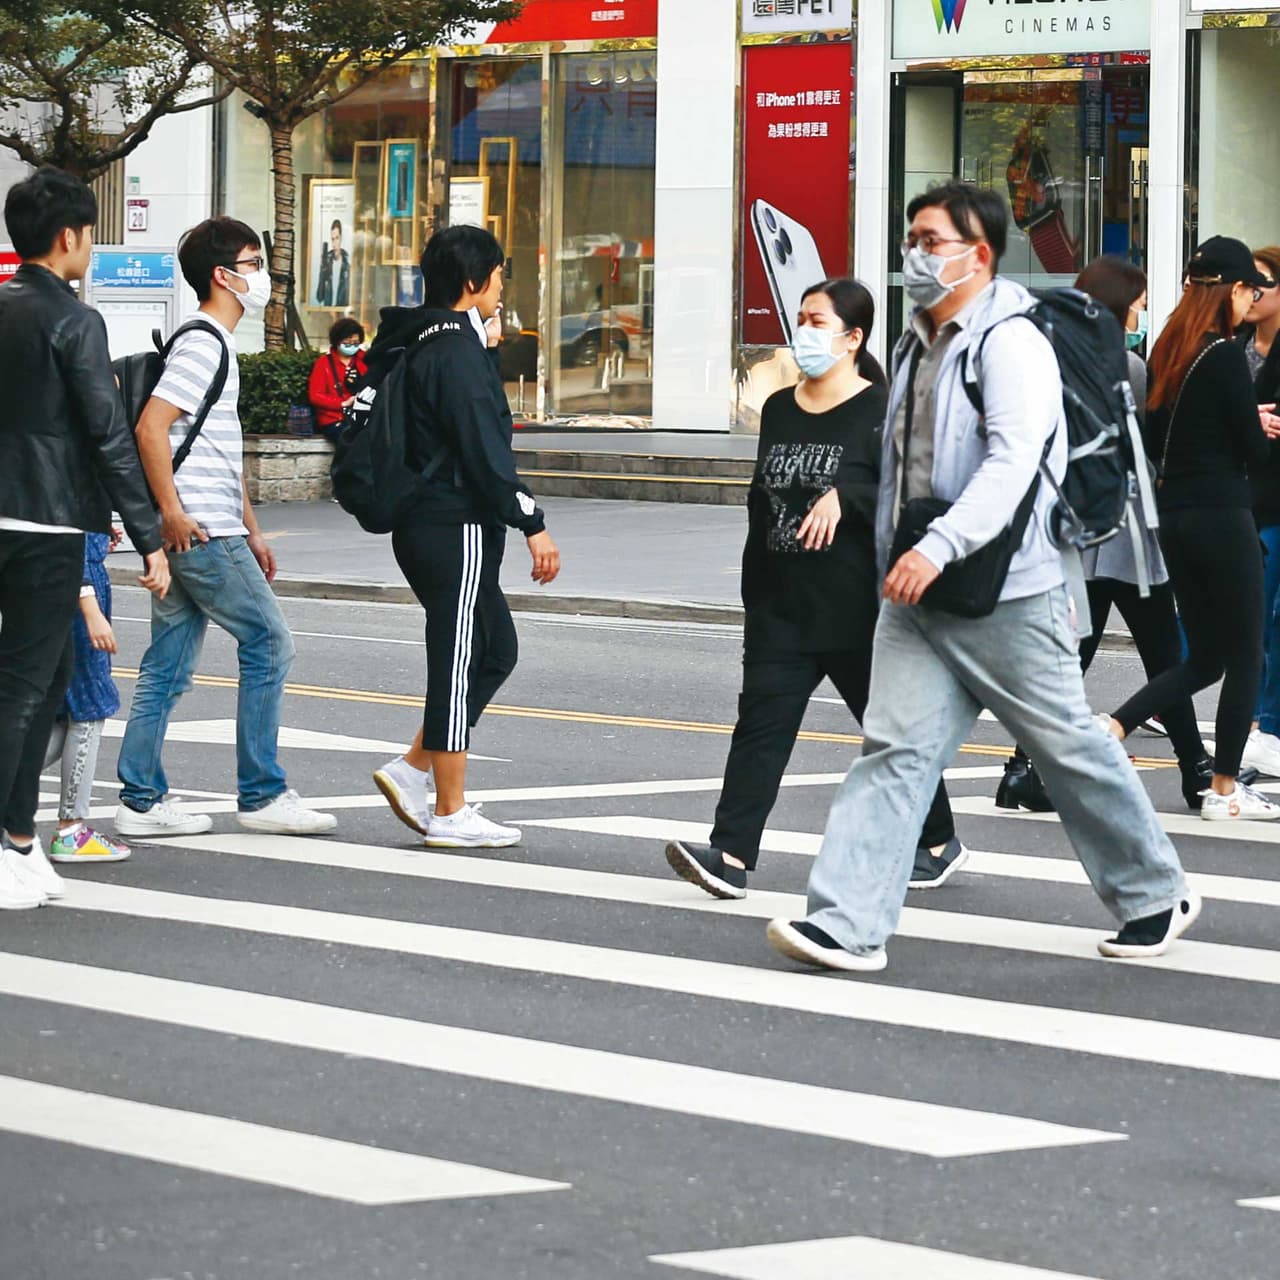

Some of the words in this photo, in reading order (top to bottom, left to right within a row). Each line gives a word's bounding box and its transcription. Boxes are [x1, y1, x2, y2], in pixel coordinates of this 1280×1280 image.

[1004, 15, 1113, 35] CINEMAS
[418, 323, 440, 342] NIKE
[441, 321, 462, 332] AIR
